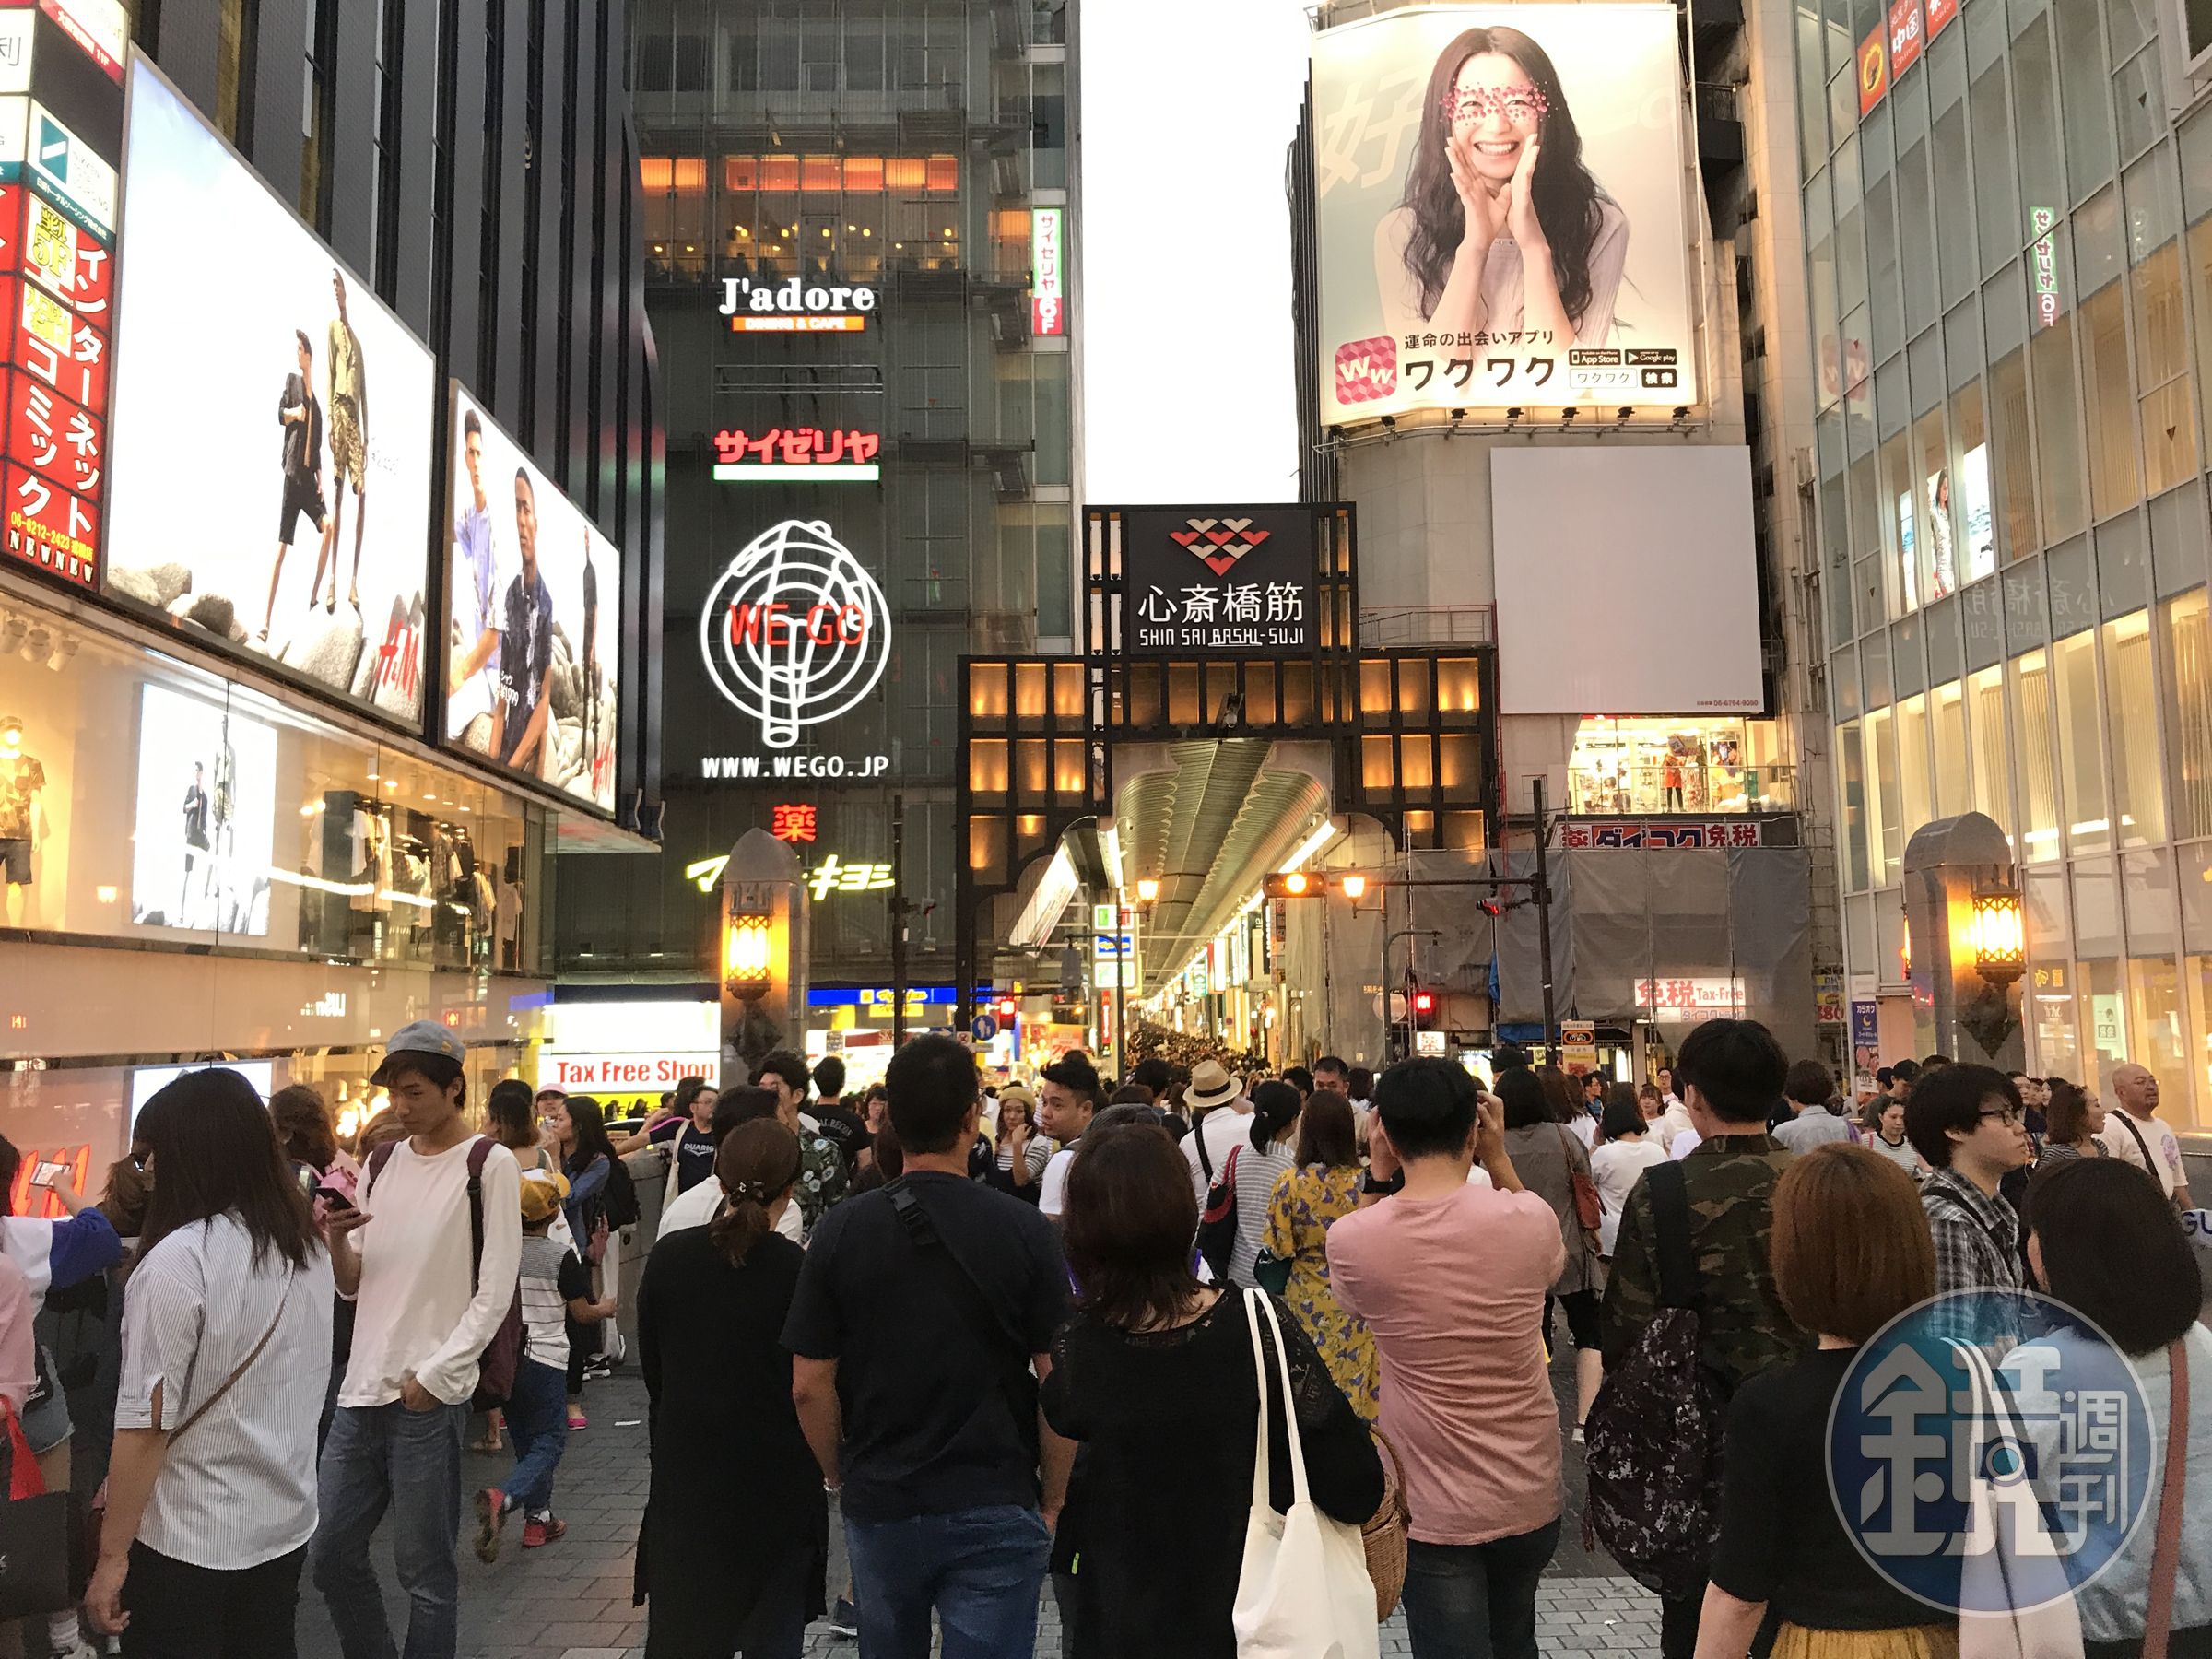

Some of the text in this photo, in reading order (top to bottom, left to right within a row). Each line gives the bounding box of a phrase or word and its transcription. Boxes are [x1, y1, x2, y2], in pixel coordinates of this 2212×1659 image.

[32, 222, 73, 278] 5F
[1040, 215, 1055, 290] サイゼリヤ
[719, 278, 876, 315] J'adore
[1040, 297, 1057, 334] 6F
[1405, 330, 1554, 350] 運命の出会いアプリ
[1581, 355, 1618, 365] App Store
[1640, 354, 1662, 363] Google
[1405, 357, 1555, 392] ワクワク
[1577, 372, 1630, 384] ワクワク
[18, 336, 58, 517] コミック
[713, 428, 880, 464] サイゼリヤ
[1137, 582, 1304, 624] 心斎橋筋
[1139, 629, 1175, 646] SHIN
[1181, 629, 1206, 646] SAI
[701, 755, 890, 779] WWW.WEGO.JP
[772, 804, 817, 842] 薬
[1707, 824, 1758, 847] 免税
[1637, 980, 1697, 1007] 免税
[557, 1062, 595, 1083] Tax
[602, 1061, 651, 1082] Free
